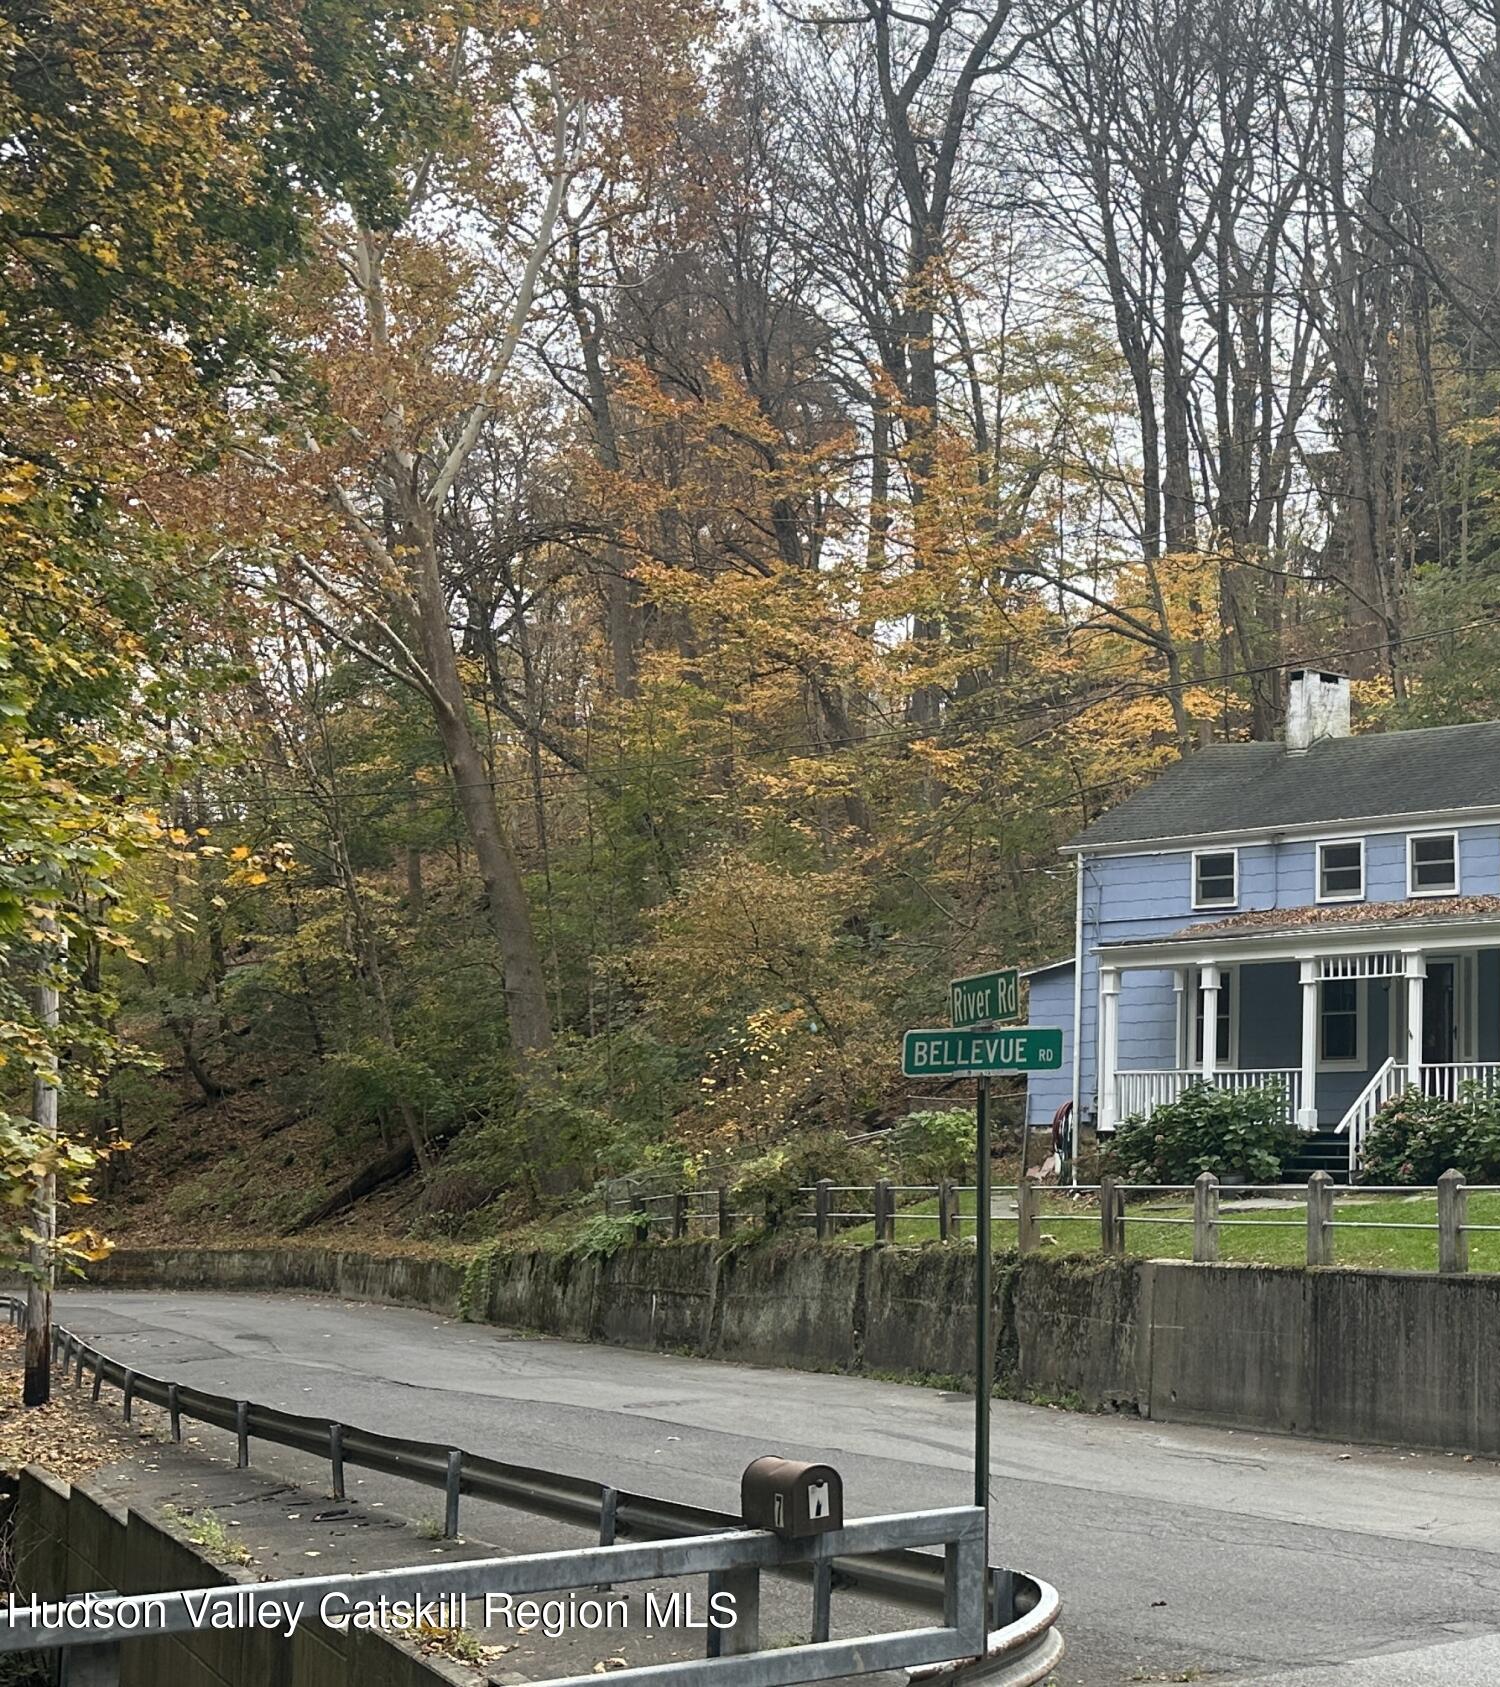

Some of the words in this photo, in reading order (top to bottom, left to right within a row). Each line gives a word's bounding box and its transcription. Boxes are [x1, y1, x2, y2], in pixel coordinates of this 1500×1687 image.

[953, 986, 991, 1023] River
[998, 976, 1016, 1014] Rd
[914, 1038, 1027, 1066] BELLEVUE
[1038, 1048, 1053, 1062] RD
